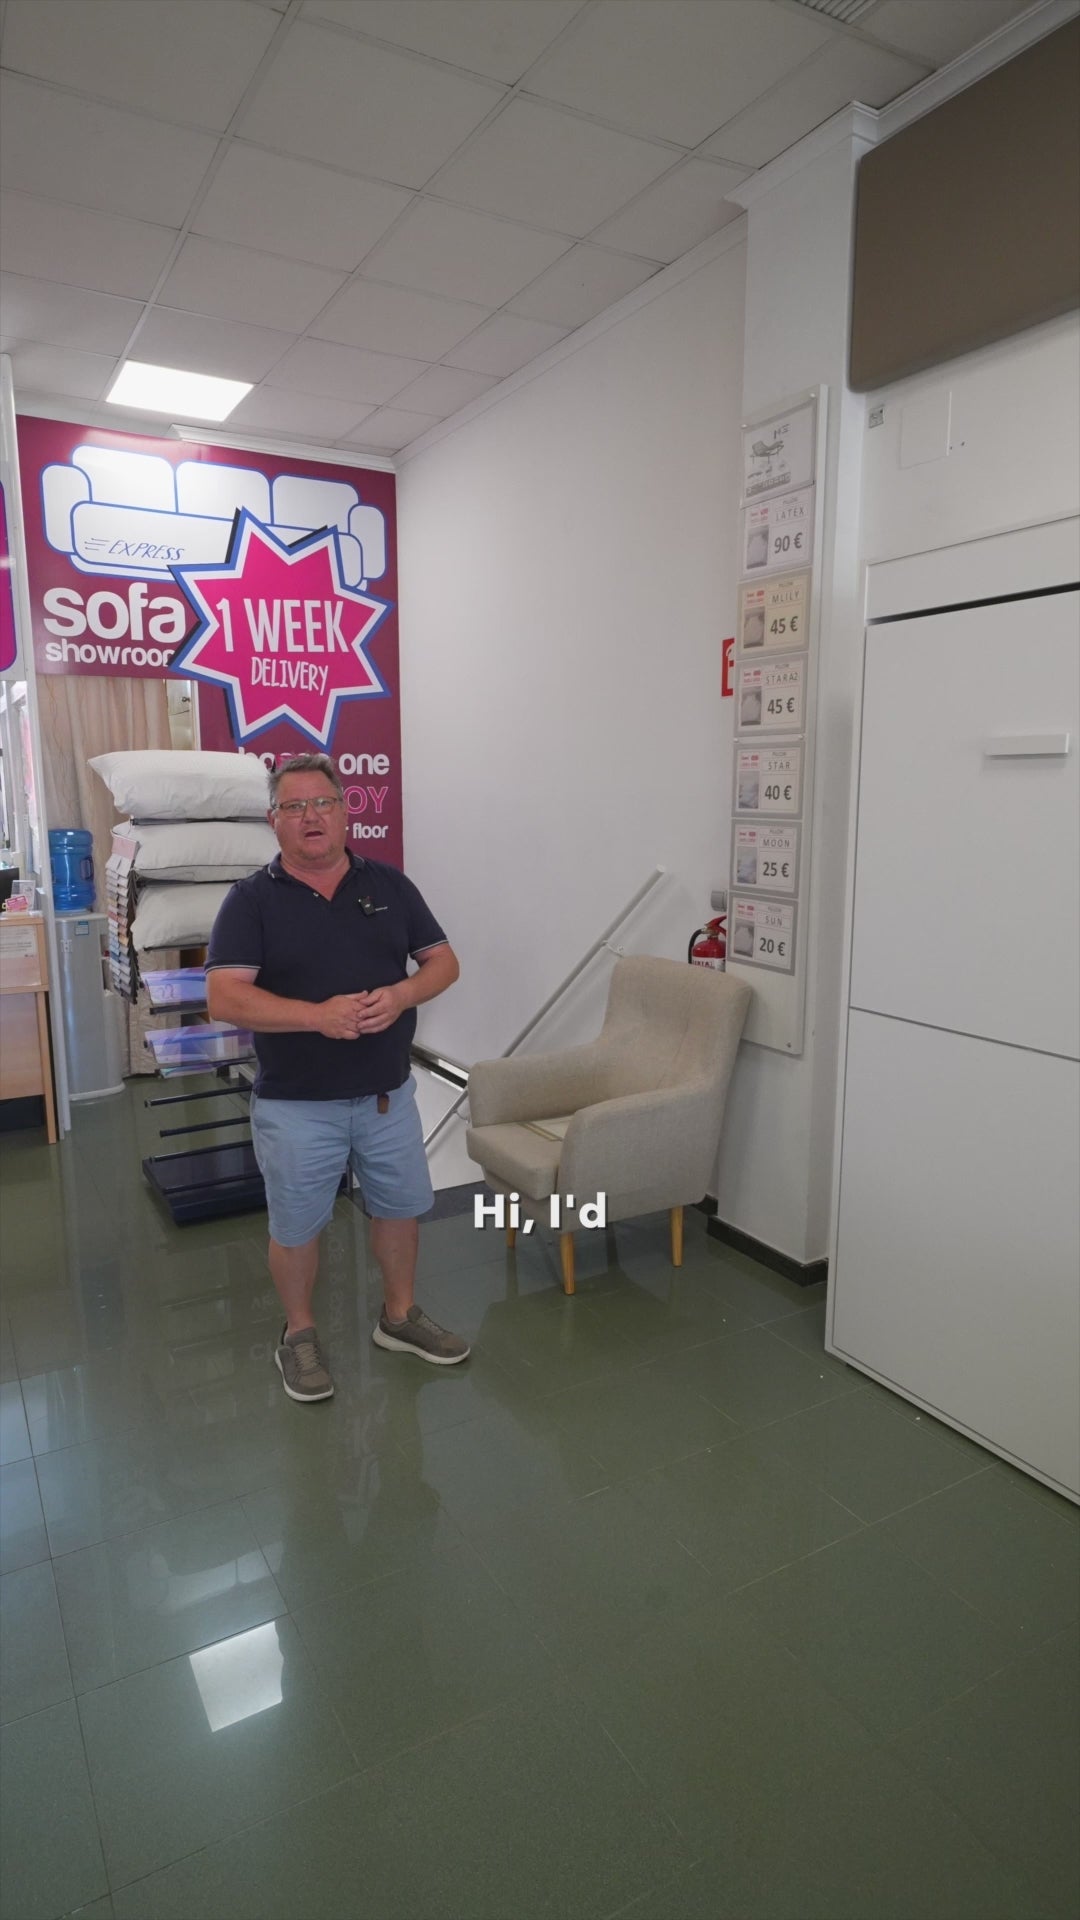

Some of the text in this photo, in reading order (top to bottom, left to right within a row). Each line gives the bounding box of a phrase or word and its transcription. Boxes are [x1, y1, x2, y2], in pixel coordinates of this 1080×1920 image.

[775, 507, 804, 521] LATEX
[108, 539, 185, 561] EXPRESS
[774, 531, 803, 554] 90 €
[771, 590, 800, 604] MLILY
[43, 582, 186, 643] sofa
[215, 597, 350, 653] 1 WEEK
[770, 615, 799, 635] 45 €
[251, 656, 329, 696] DELIVERY
[767, 697, 795, 715] 45 €
[338, 753, 390, 776] one
[767, 761, 791, 771] STAR
[764, 784, 792, 800] 40 €
[352, 822, 389, 839] floor
[762, 838, 790, 848] MOON
[762, 861, 790, 878] 25 €
[765, 915, 783, 927] SUN
[759, 937, 786, 957] 20 €
